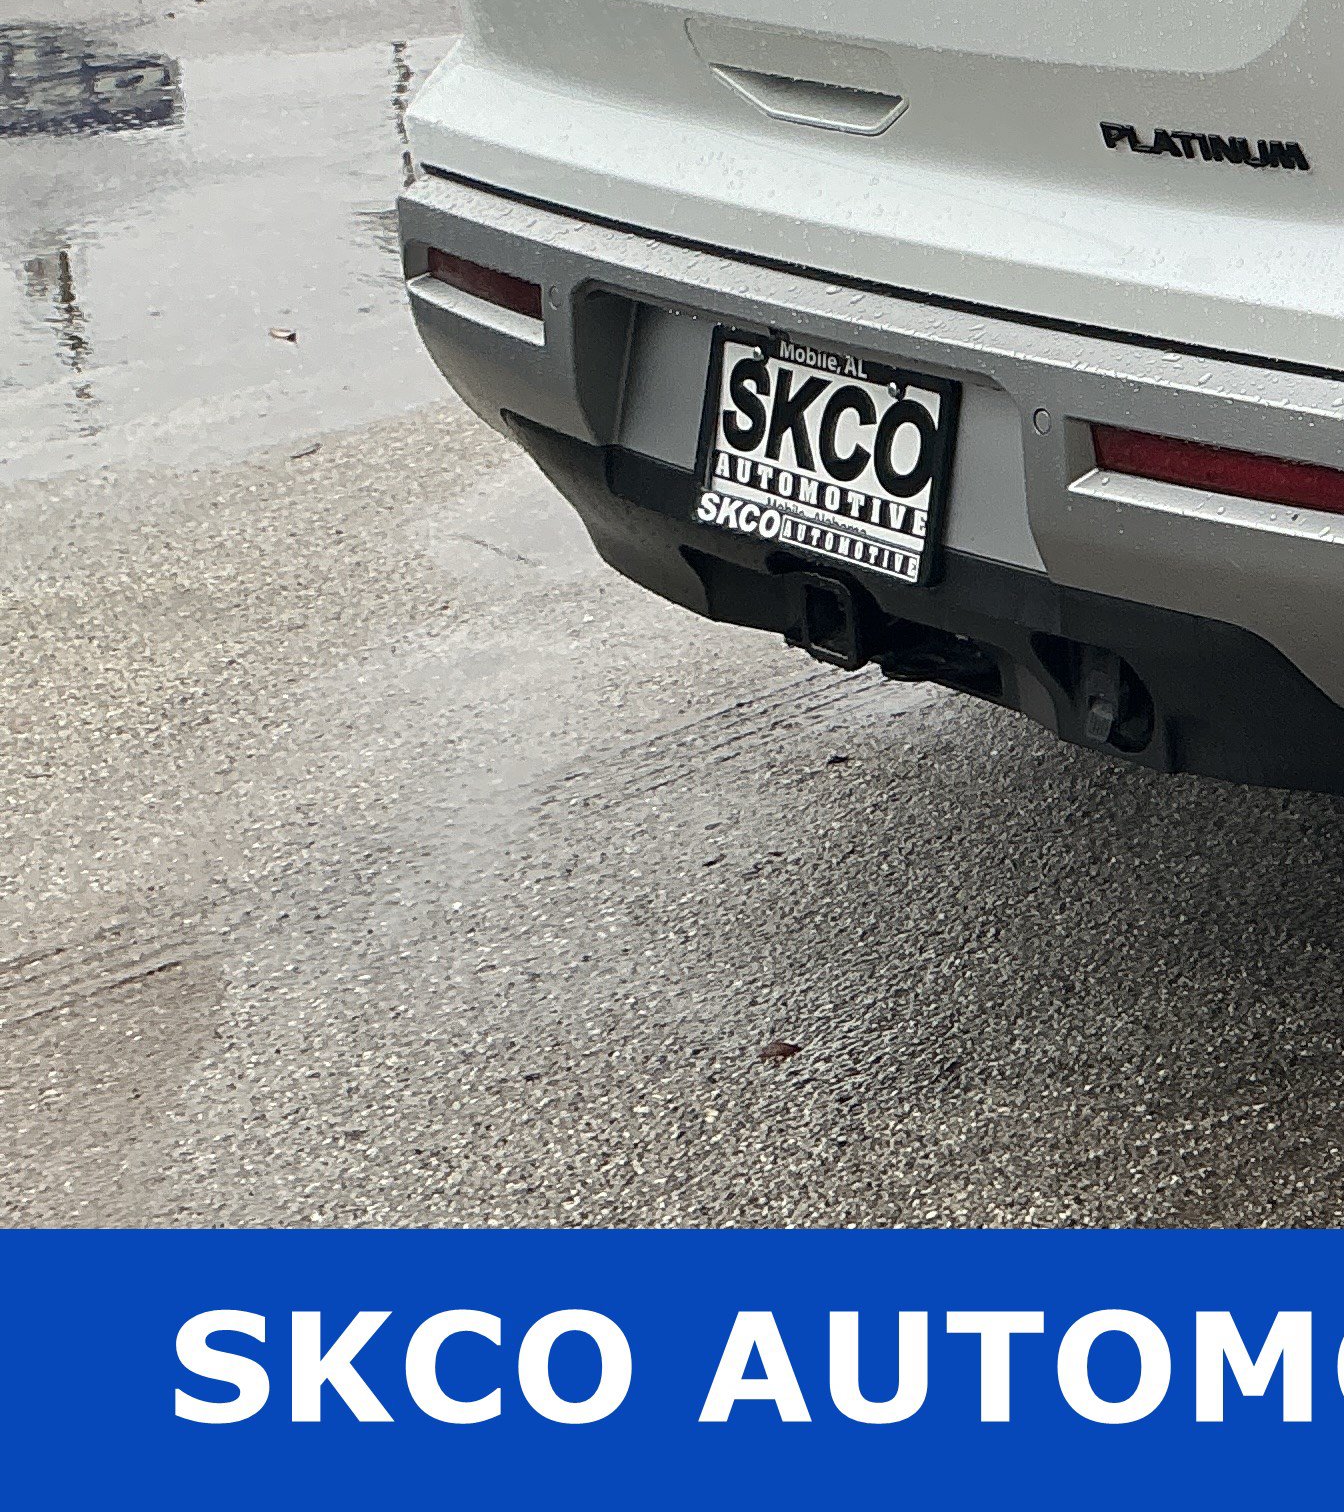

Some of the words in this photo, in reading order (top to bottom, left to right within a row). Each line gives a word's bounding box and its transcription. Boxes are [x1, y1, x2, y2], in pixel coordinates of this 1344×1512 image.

[1099, 121, 1311, 172] PLATINUM
[779, 341, 843, 374] Mobile,
[844, 355, 868, 379] AL
[723, 357, 938, 498] SKCO
[697, 491, 781, 539] SKCO
[783, 518, 918, 578] AUTOMOTIVE
[715, 452, 928, 537] AUTOMOTIVE
